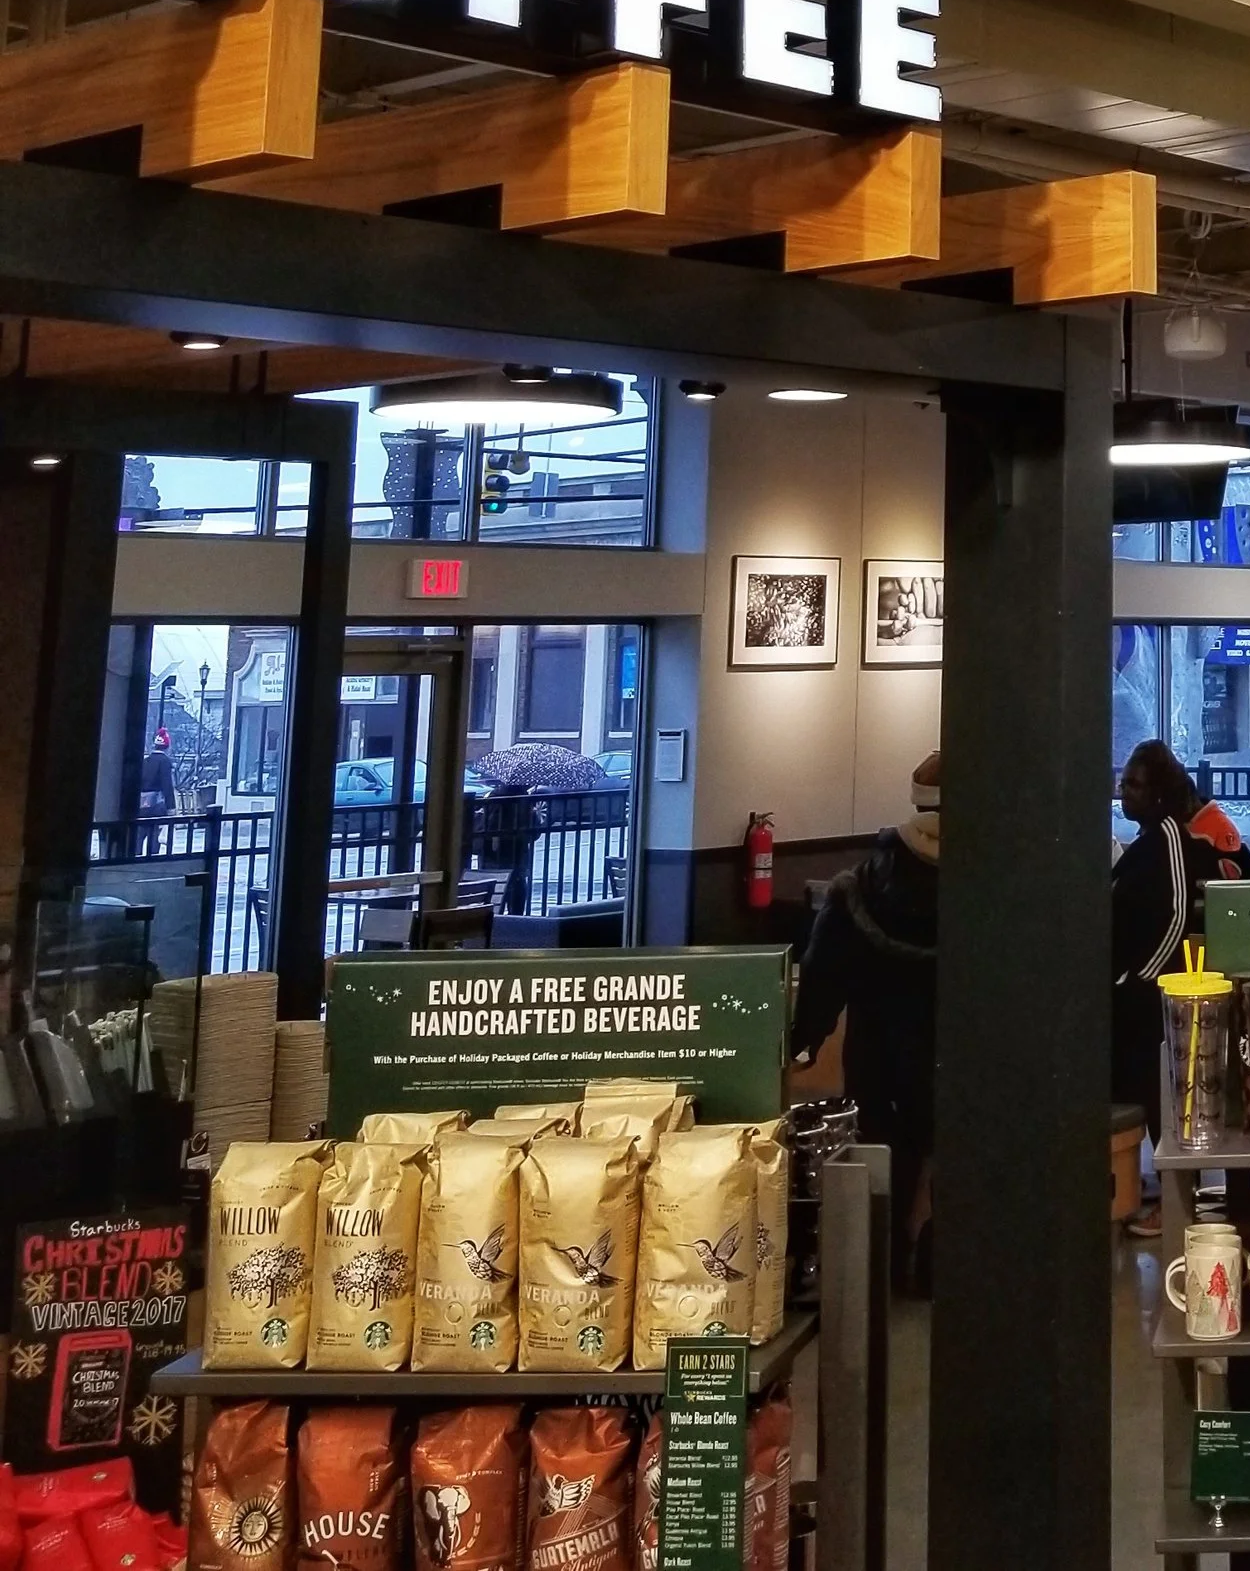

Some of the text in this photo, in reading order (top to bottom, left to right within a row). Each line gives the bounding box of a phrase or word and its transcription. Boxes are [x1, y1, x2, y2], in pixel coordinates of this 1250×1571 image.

[422, 560, 463, 595] EXIT
[428, 974, 685, 1005] ENJOY A FREE GRANDE
[411, 1005, 701, 1037] HANDCRAFTED BEVERAGE
[373, 1056, 392, 1064] With
[394, 1055, 407, 1064] the
[409, 1055, 446, 1064] Purchase
[448, 1054, 457, 1063] of
[459, 1054, 490, 1063] Holiday
[491, 1053, 531, 1063] Packaged
[532, 1052, 559, 1061] Coffee
[571, 1051, 602, 1061] Holiday
[604, 1050, 656, 1060] Merchandise
[658, 1050, 676, 1058] Item
[679, 1049, 696, 1058] $10
[709, 1048, 737, 1058] Higher
[70, 1218, 141, 1238] Starbucks
[220, 1206, 281, 1235] WILLOW
[325, 1207, 385, 1237] WILLOW
[23, 1225, 186, 1273] CHRISTMAS
[62, 1261, 152, 1301] BLEND
[419, 1283, 493, 1301] VERANDA
[525, 1284, 600, 1303] VERANDA
[679, 1354, 736, 1370] EARN 2 STARS
[73, 1370, 120, 1384] CHRISTMAS
[83, 1381, 115, 1393] BLEND
[670, 1411, 738, 1425] Whole Bean Coffee
[1200, 1420, 1231, 1430] Cozy Comfort
[304, 1511, 390, 1548] HOUSE
[532, 1522, 620, 1570] GUATEMALA
